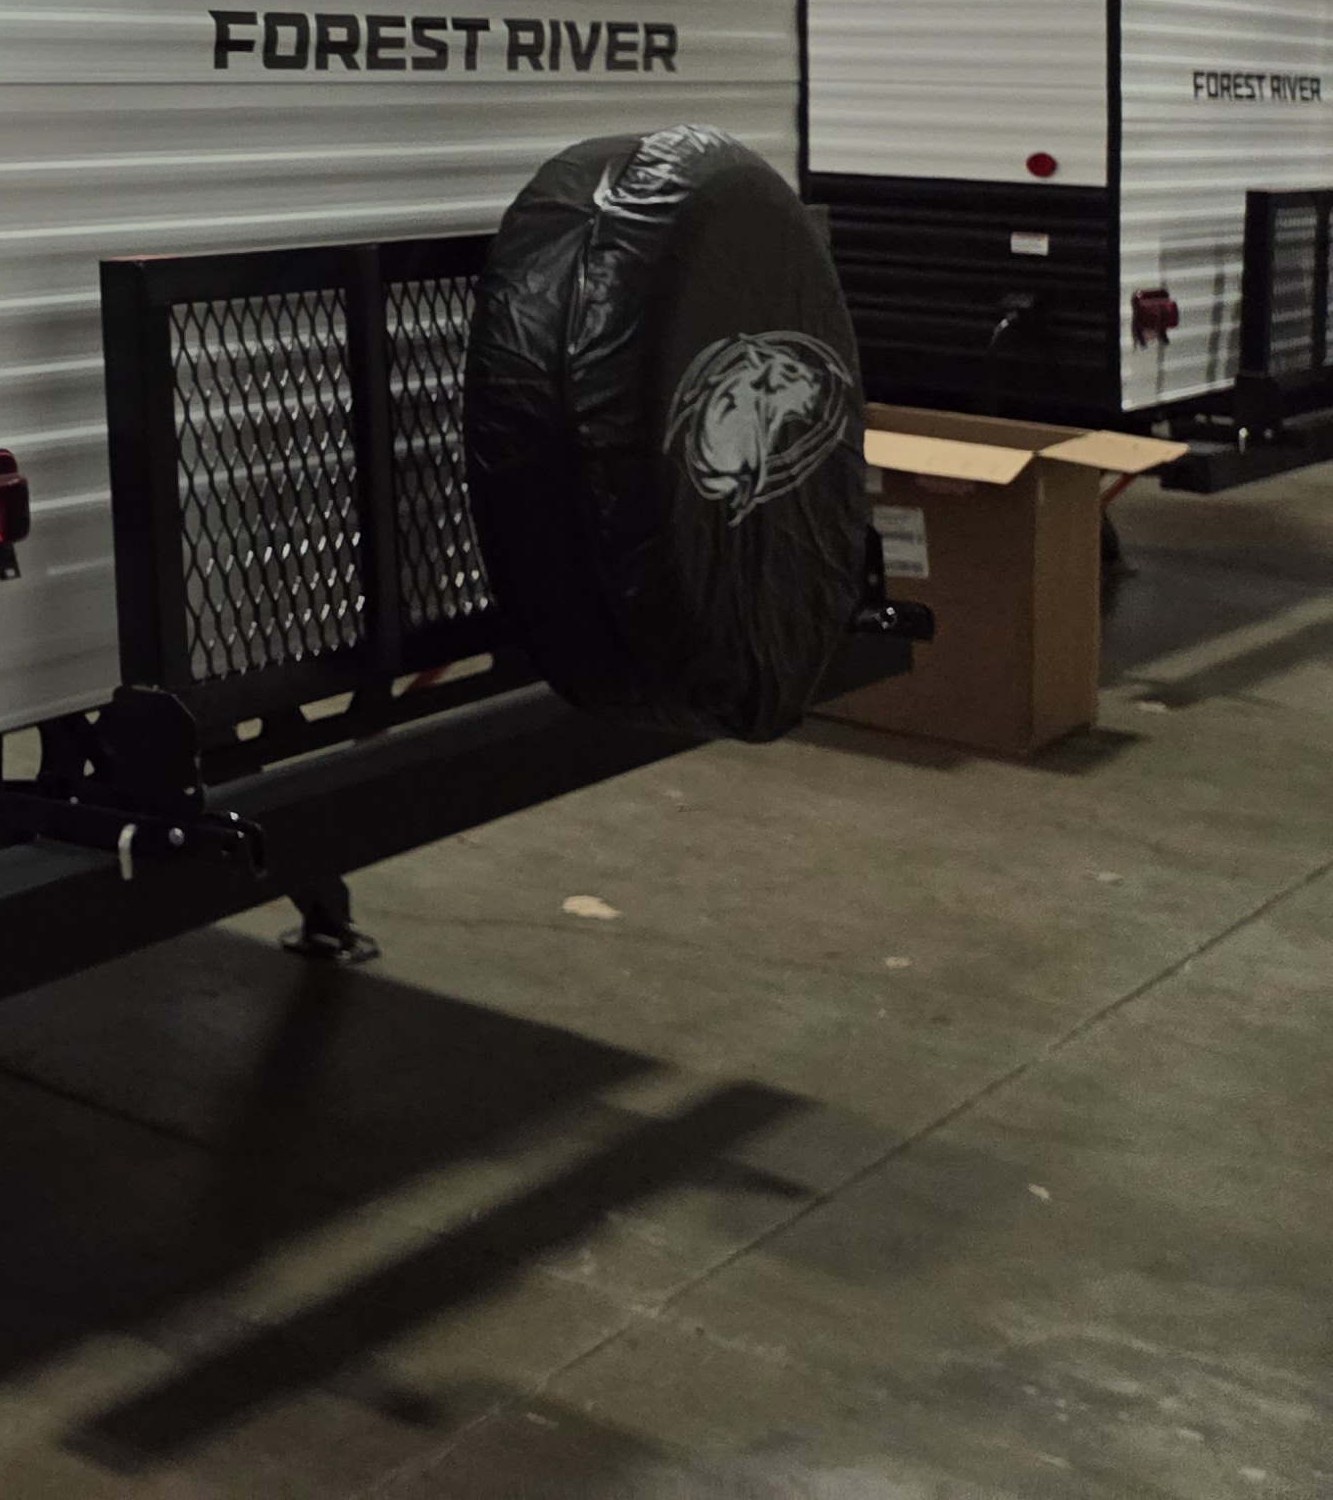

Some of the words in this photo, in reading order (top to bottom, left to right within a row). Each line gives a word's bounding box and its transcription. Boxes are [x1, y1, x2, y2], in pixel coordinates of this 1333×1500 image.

[208, 9, 491, 71] FOREST
[503, 18, 679, 74] RIVER
[1193, 71, 1266, 101] FOREST
[1270, 74, 1322, 102] RIVER
